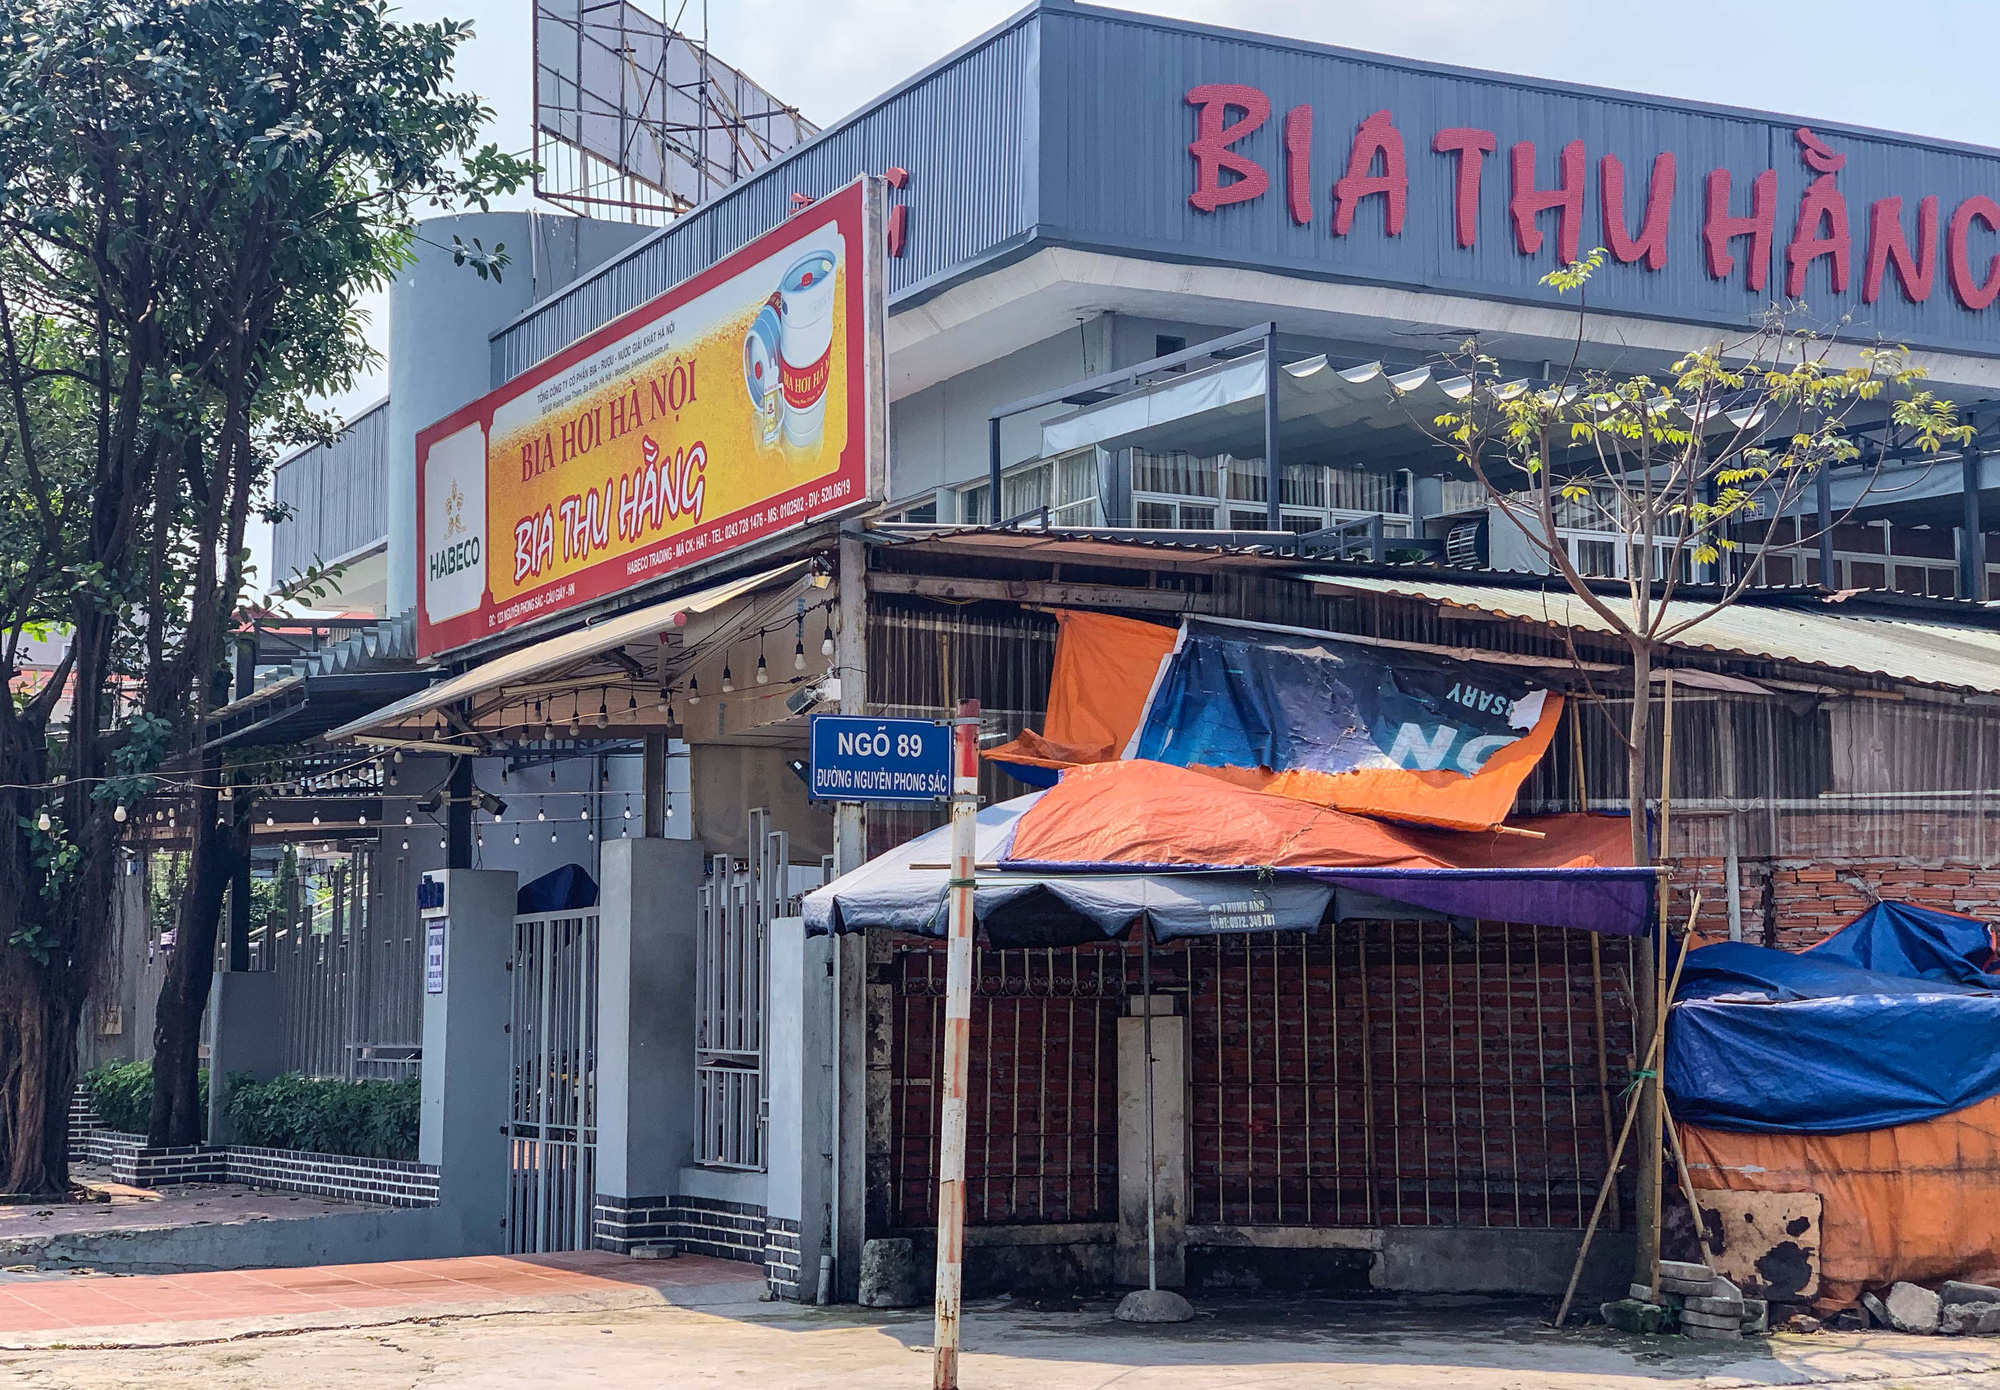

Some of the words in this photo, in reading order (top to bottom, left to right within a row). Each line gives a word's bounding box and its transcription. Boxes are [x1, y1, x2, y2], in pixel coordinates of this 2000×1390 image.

[1184, 84, 1408, 236] BIA
[1432, 126, 1676, 271] THU
[521, 432, 556, 483] BIA
[560, 406, 602, 465] HƠI
[608, 377, 644, 442] HÀ
[649, 356, 698, 423] NỘI
[514, 503, 553, 585] BIA
[558, 476, 613, 563] THU
[617, 434, 708, 543] HẰNG
[626, 556, 649, 576] HABECO
[649, 546, 673, 567] TRADING
[696, 533, 708, 551] HAT
[711, 527, 724, 544] TEL:
[724, 521, 738, 540] 0243
[738, 517, 749, 535] 728
[750, 511, 764, 531] 1476
[767, 506, 779, 524] MS:
[779, 496, 804, 519] 0102502
[808, 489, 820, 509] ĐV:
[821, 478, 851, 504] 520.06/19
[430, 536, 480, 581] HABECO
[838, 725, 891, 757] NGÕ
[897, 733, 923, 758] 89
[816, 765, 852, 789] ĐƯỜNG
[893, 772, 926, 792] PHONG
[928, 769, 947, 793] SẮC
[1221, 901, 1248, 914] TRUNG
[1262, 913, 1275, 927] 781
